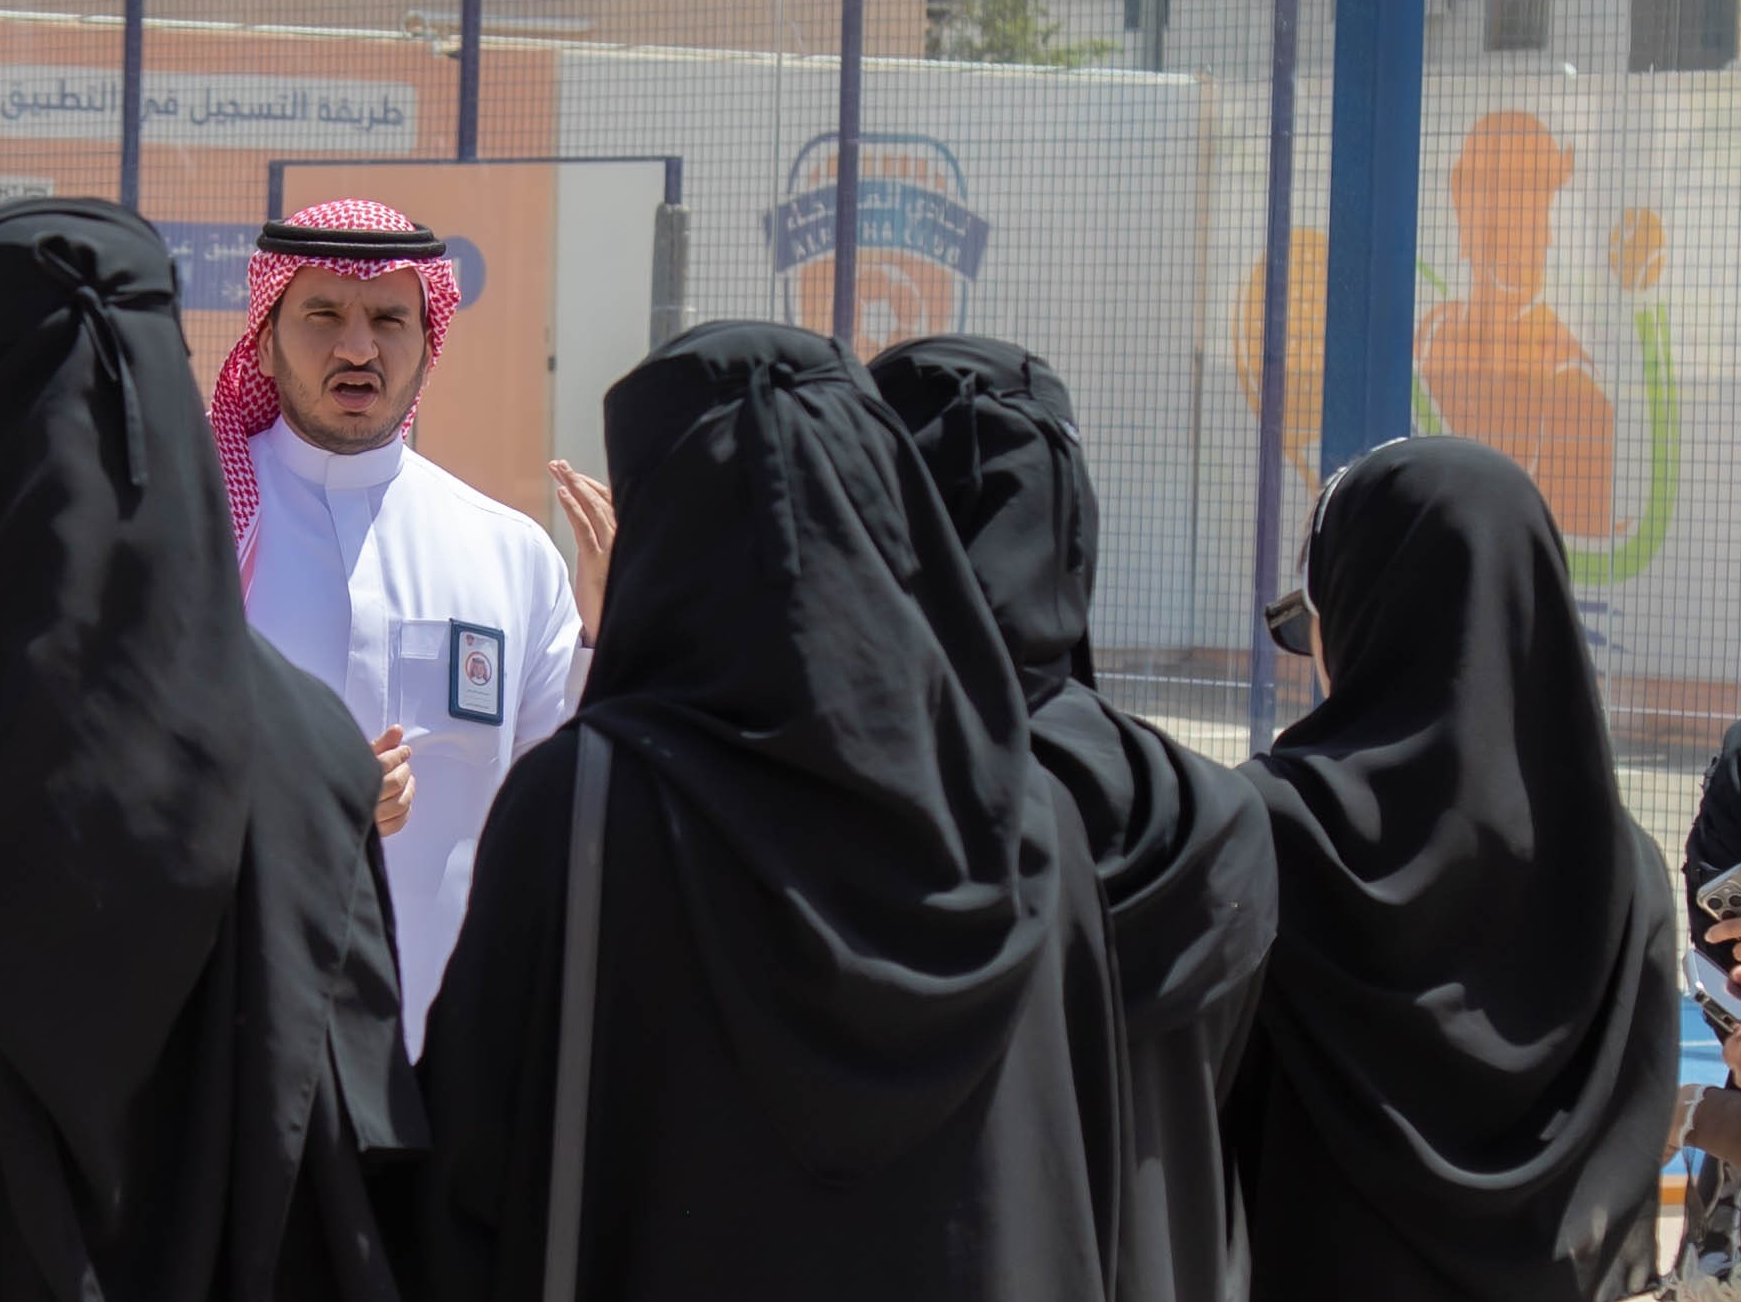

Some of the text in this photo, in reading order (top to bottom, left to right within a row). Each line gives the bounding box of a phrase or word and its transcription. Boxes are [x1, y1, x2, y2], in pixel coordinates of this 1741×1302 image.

[0, 78, 117, 121] التطبيق
[189, 85, 309, 127] التسجيل
[317, 93, 404, 132] طريقة
